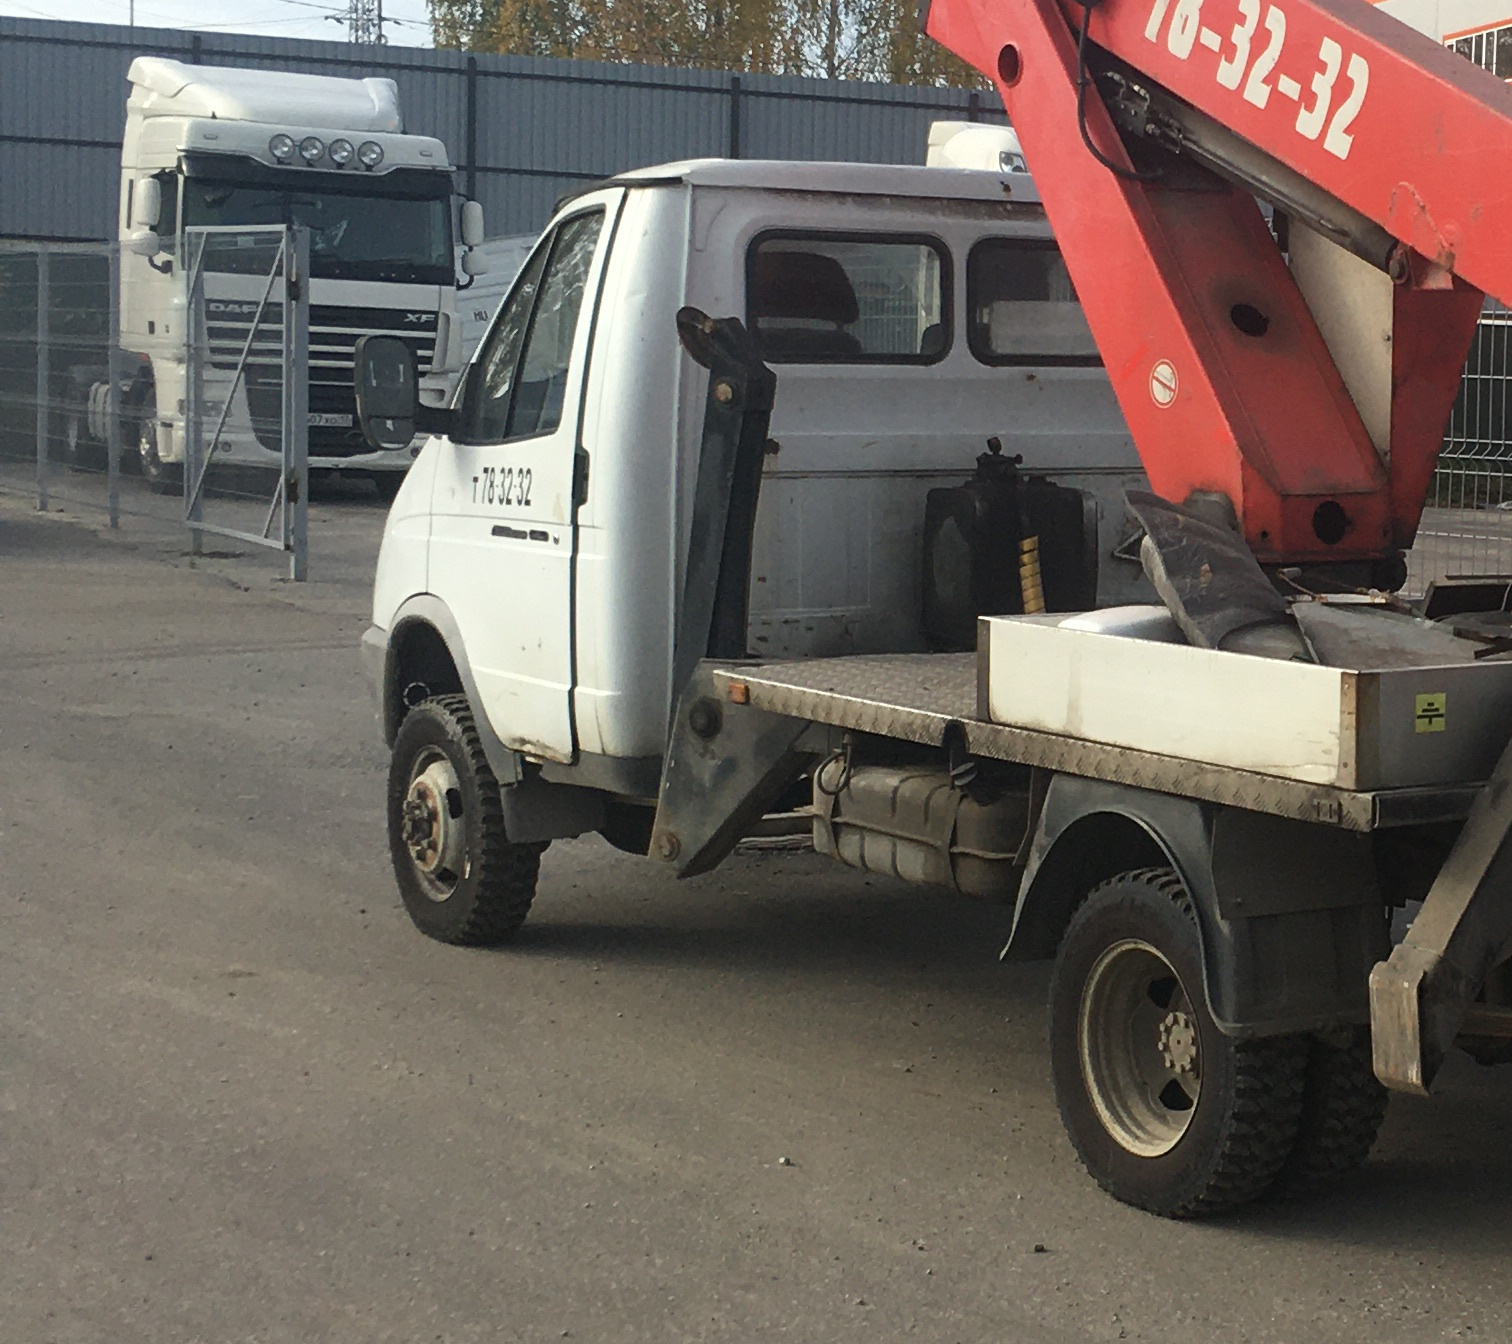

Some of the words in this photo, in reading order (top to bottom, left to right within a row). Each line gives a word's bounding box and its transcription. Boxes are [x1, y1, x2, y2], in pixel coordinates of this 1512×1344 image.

[209, 302, 260, 313] DAF
[404, 313, 435, 323] XF
[481, 466, 532, 506] 78-32-32
